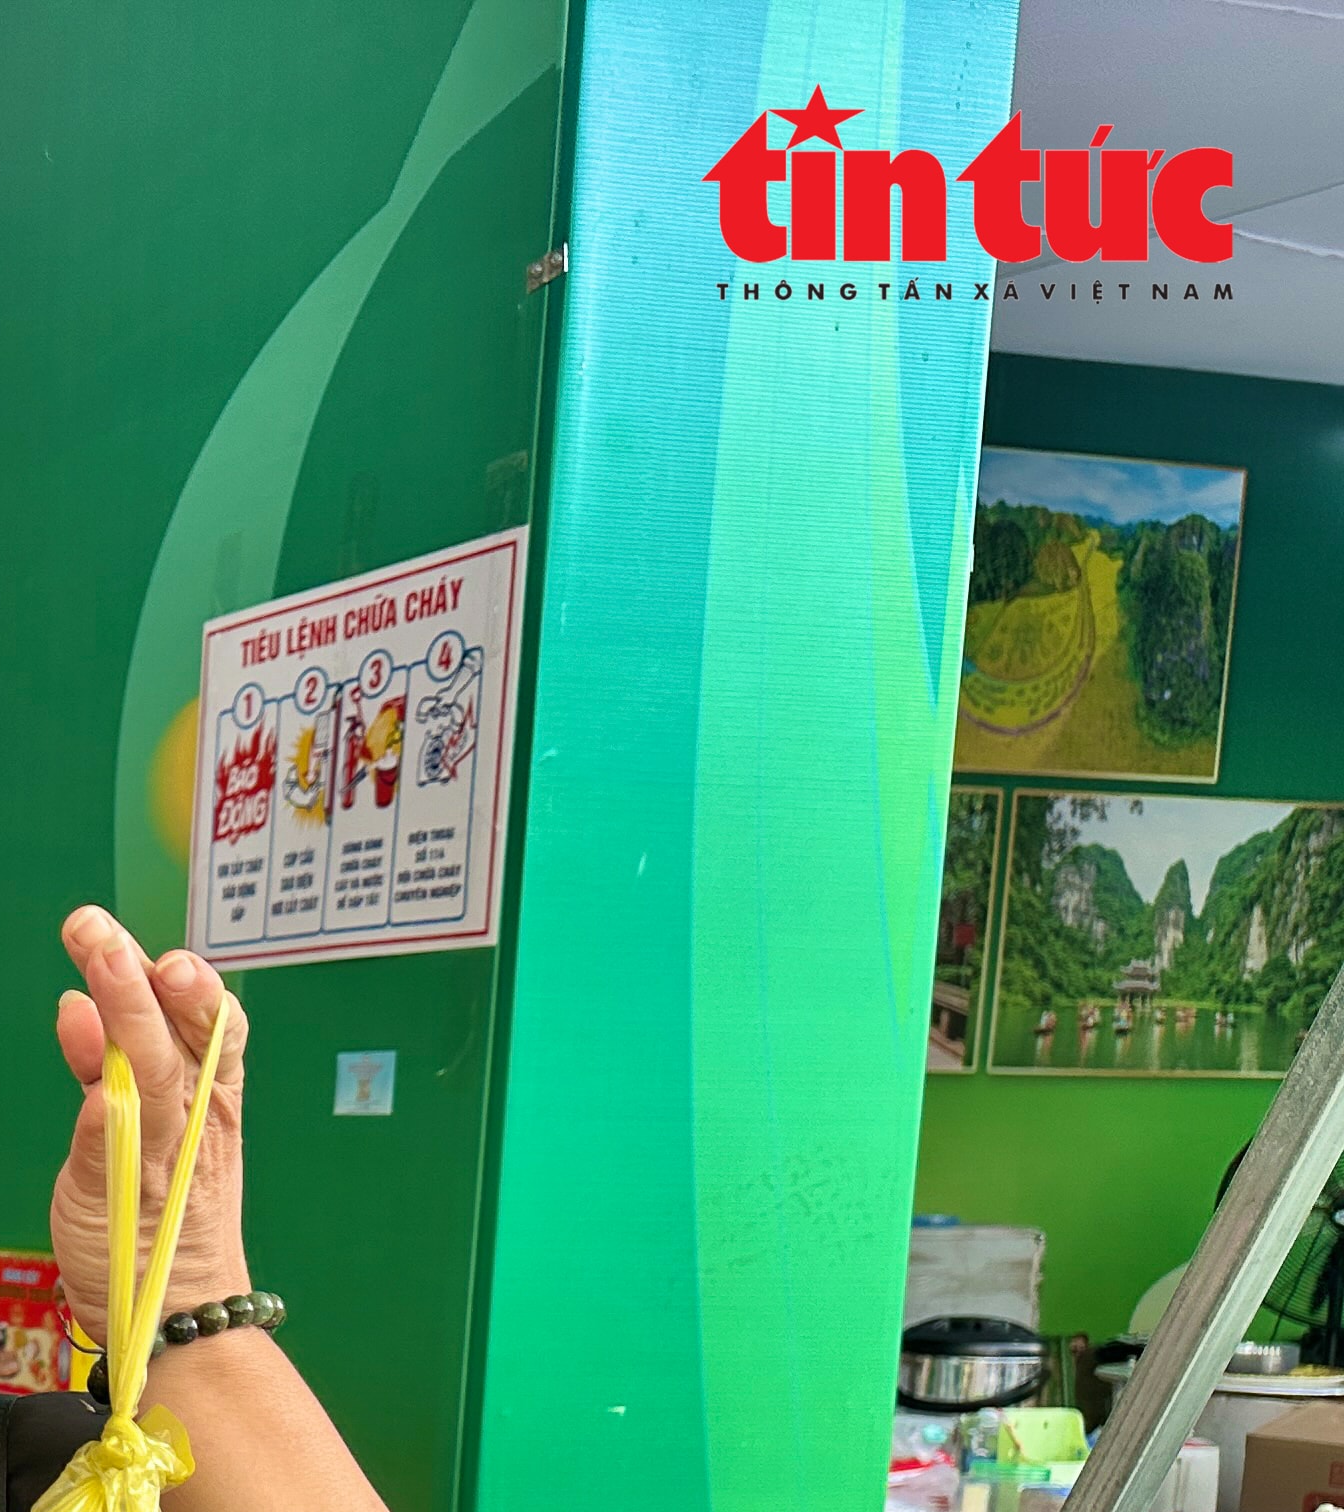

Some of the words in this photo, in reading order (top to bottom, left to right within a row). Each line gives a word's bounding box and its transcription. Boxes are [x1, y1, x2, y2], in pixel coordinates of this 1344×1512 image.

[241, 628, 281, 668] TIÊU
[286, 615, 337, 660] LỆNH
[343, 594, 397, 640] CHỮA
[404, 575, 464, 623] CHÁY
[437, 640, 452, 671] 4
[368, 659, 383, 690] 3
[303, 676, 318, 705] 2
